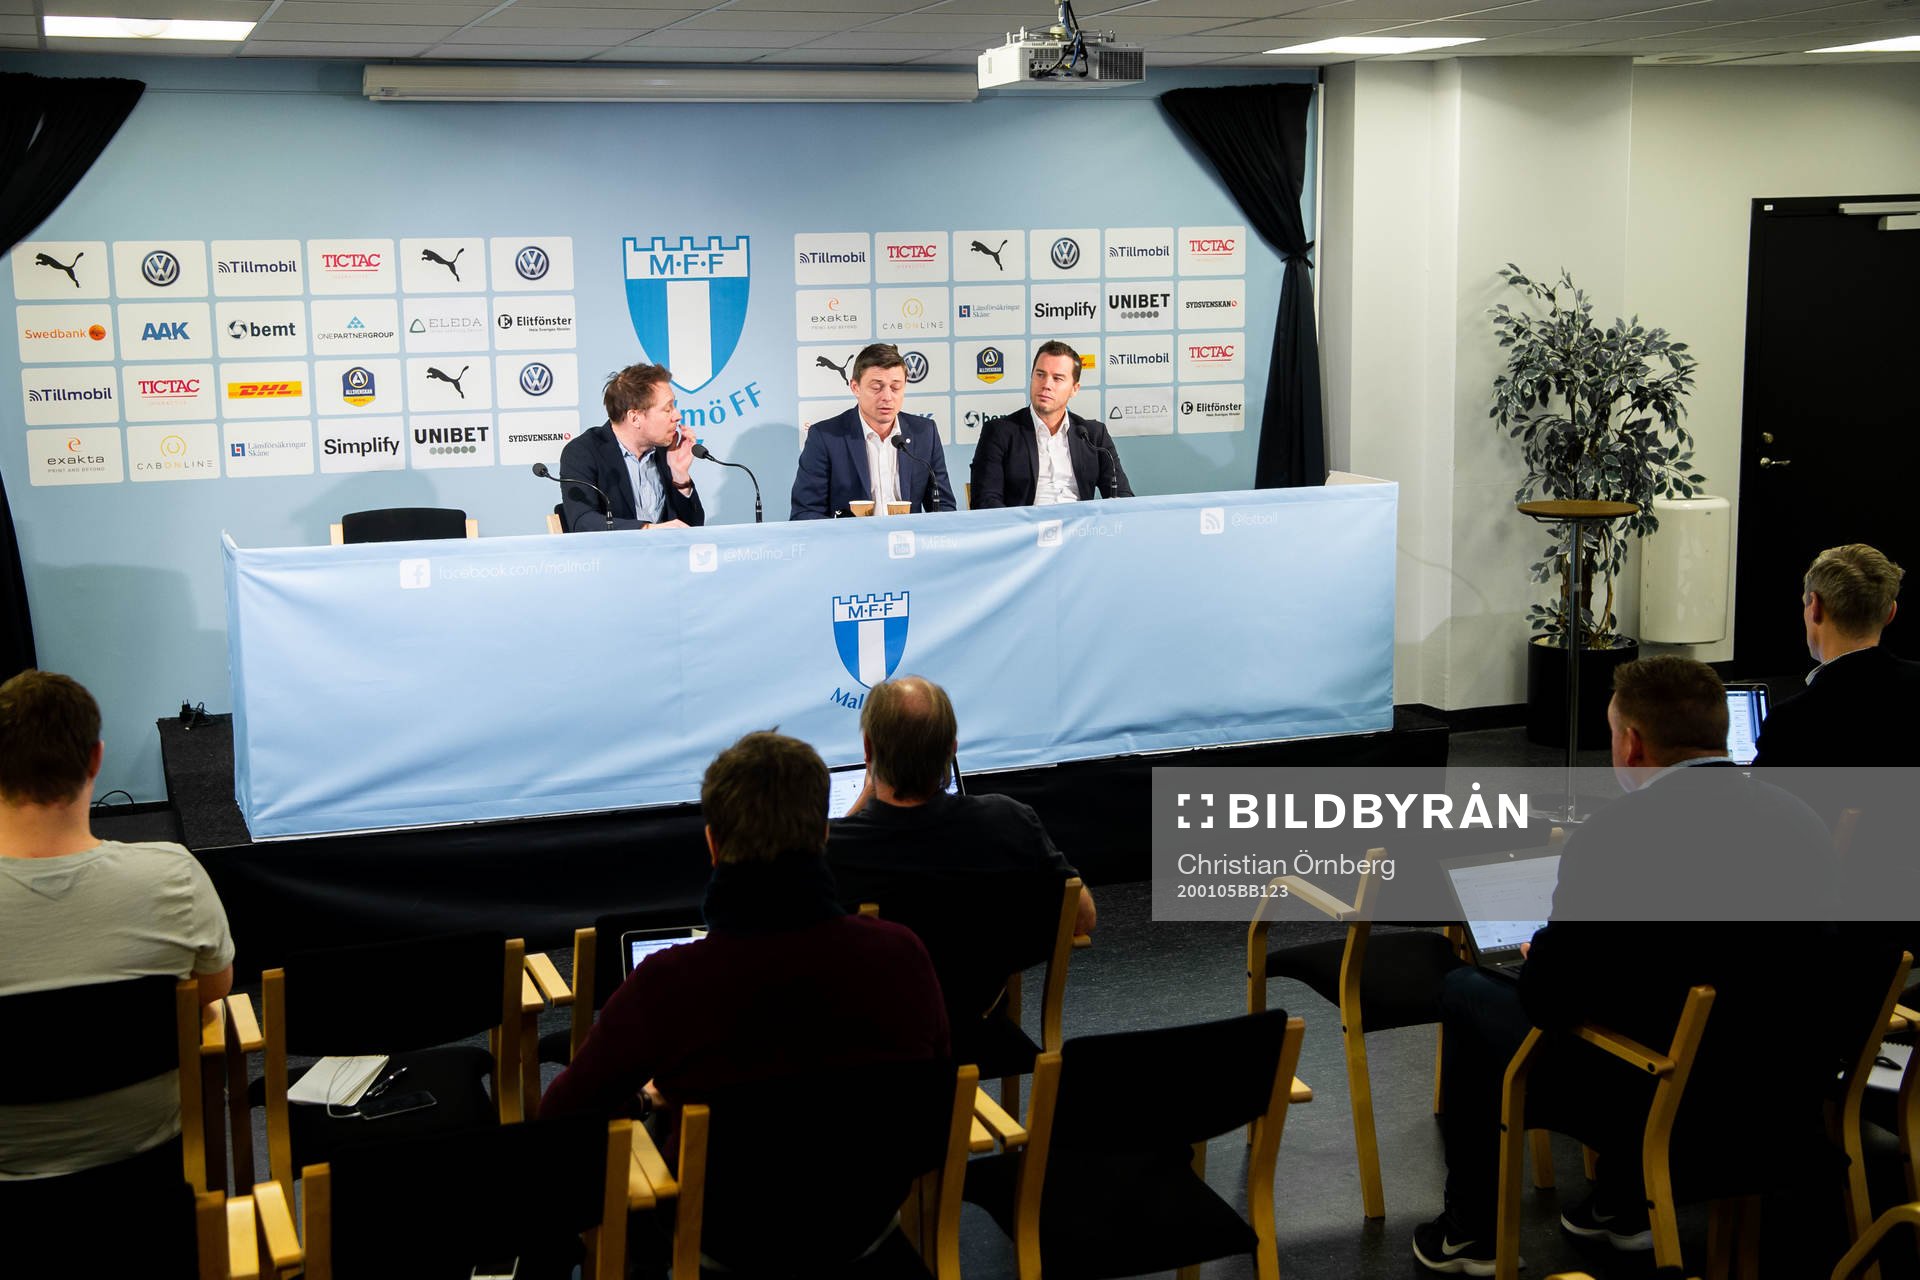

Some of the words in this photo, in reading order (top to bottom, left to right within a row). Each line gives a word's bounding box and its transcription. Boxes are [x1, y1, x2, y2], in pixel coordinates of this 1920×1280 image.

[1118, 246, 1170, 257] Tillmobil
[1189, 239, 1235, 252] TICTAC
[810, 252, 866, 264] Tillmobil
[887, 245, 936, 259] TICTAC
[322, 253, 381, 268] TICTAC
[229, 261, 297, 273] Tillmobil
[1109, 294, 1171, 309] UNIBET
[1186, 300, 1232, 309] SYDSVENSKAN
[1034, 302, 1097, 320] Simplify
[429, 317, 483, 329] ELEDA
[517, 316, 572, 327] Elitfönster
[811, 314, 857, 323] exakta
[25, 328, 87, 340] Swedbank
[141, 322, 190, 341] AAK
[250, 322, 296, 337] bemt
[1189, 345, 1234, 359] TICTAC
[1118, 353, 1169, 365] Tillmobil
[138, 379, 200, 394] TICTAC
[238, 384, 296, 396] DHL
[41, 387, 112, 402] Tillmobil
[729, 381, 761, 416] FF
[1125, 405, 1168, 415] ELEDA
[1196, 402, 1242, 413] Elitfönster
[414, 426, 489, 444] UNIBET
[508, 433, 564, 443] SYDSVENSKAN
[324, 436, 400, 457] Simplify
[47, 455, 105, 465] exakta
[830, 687, 865, 710] Mal
